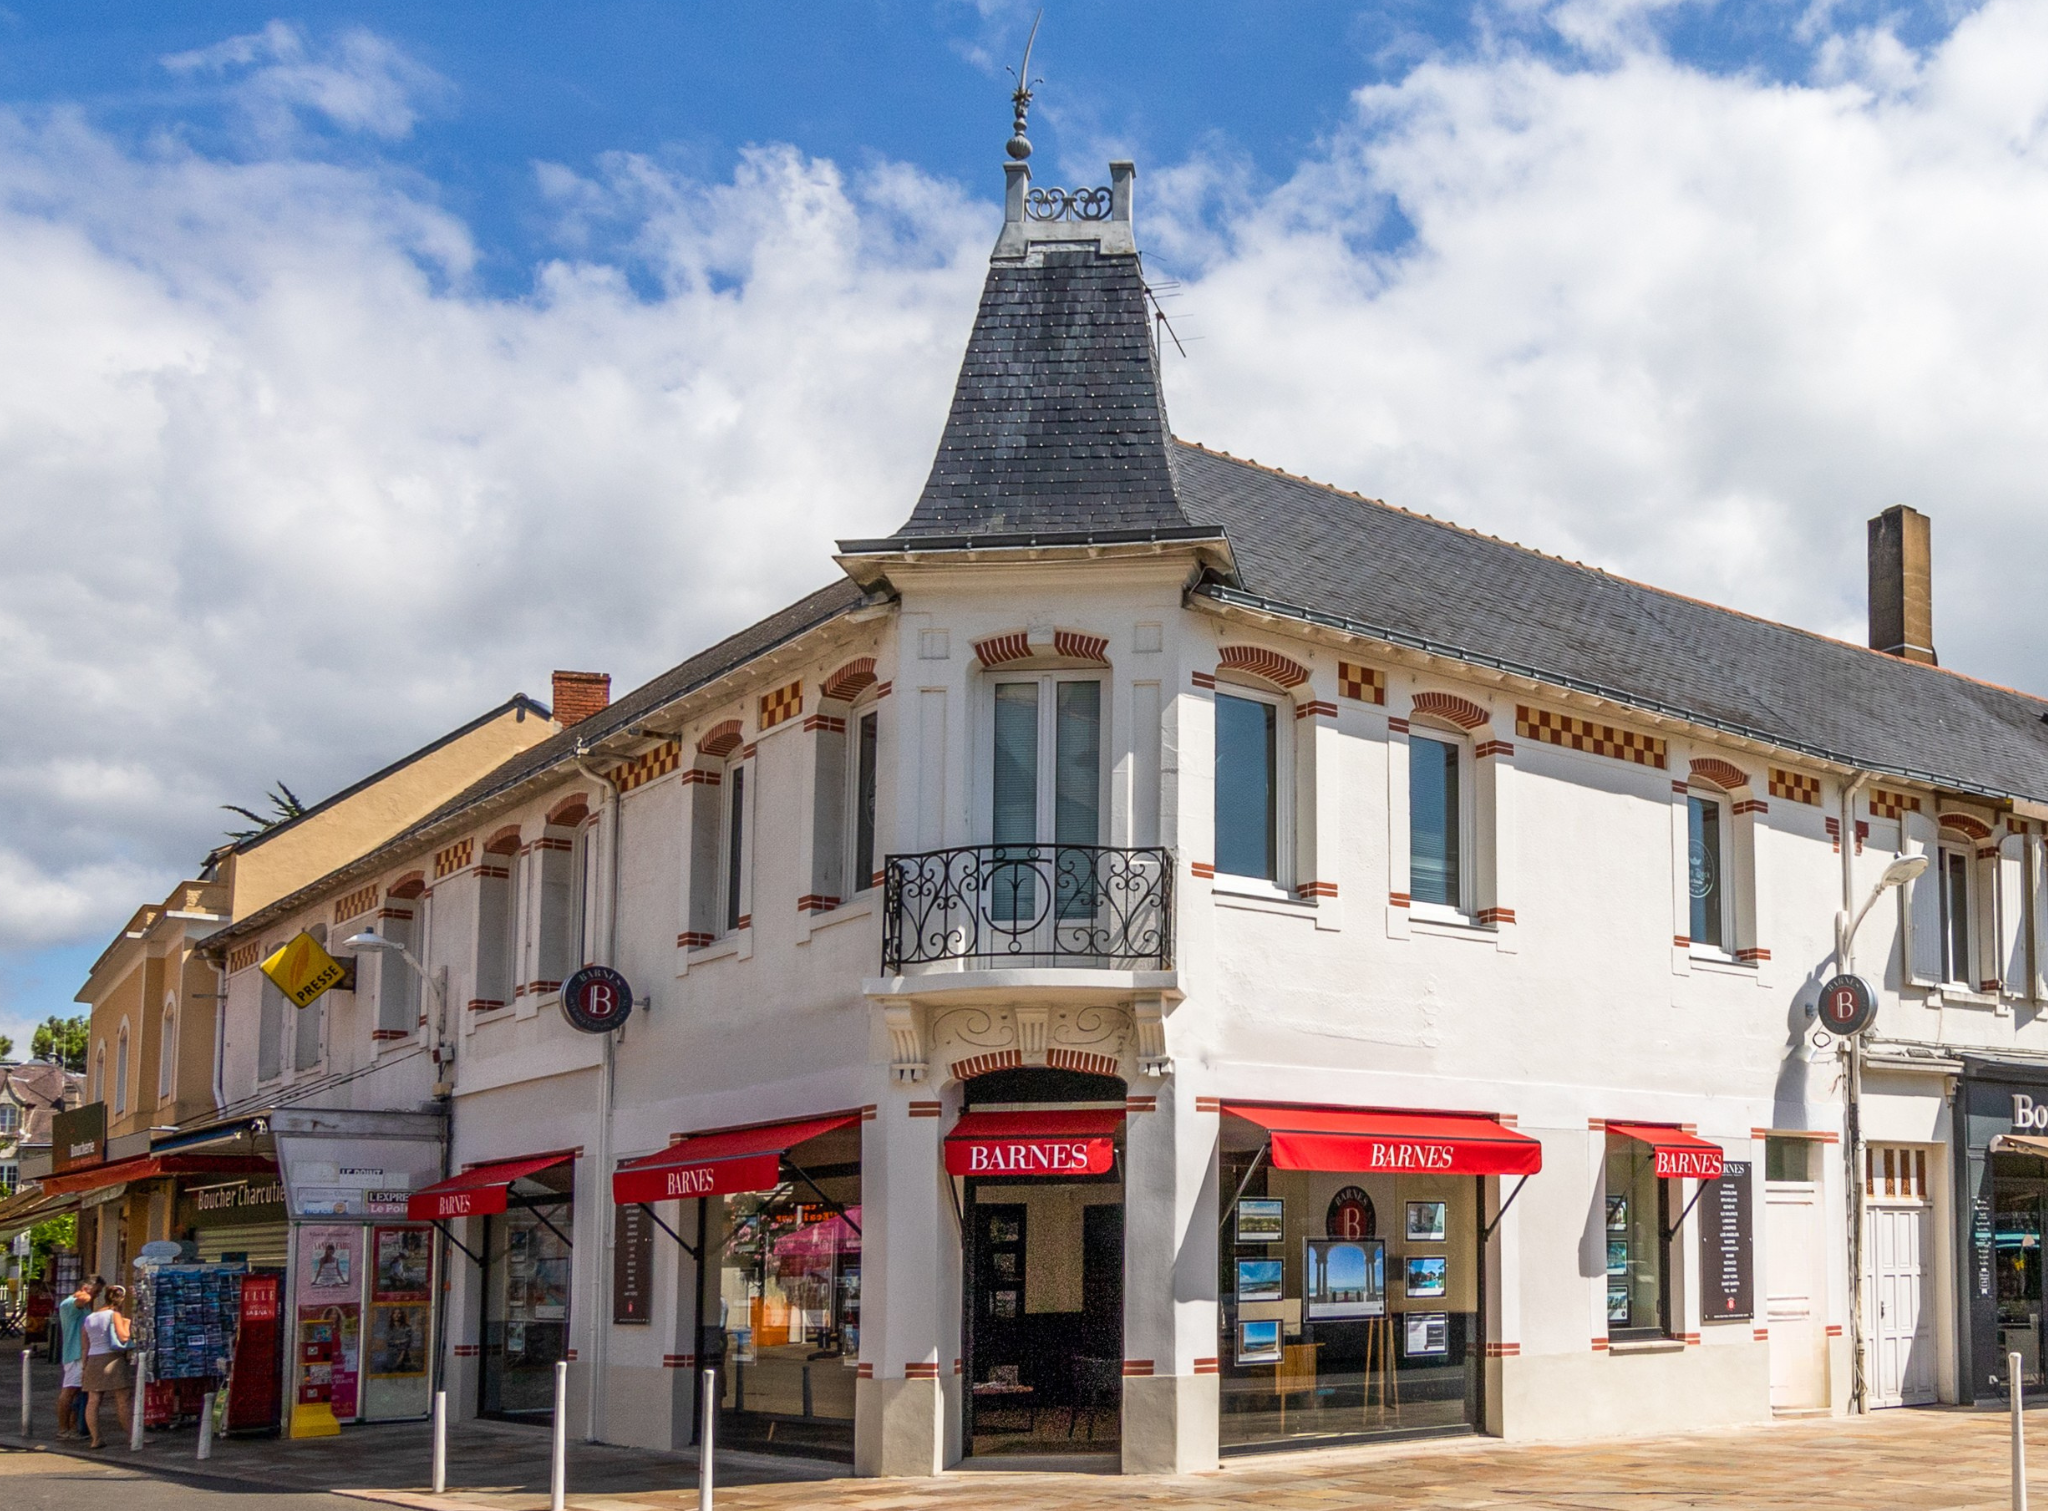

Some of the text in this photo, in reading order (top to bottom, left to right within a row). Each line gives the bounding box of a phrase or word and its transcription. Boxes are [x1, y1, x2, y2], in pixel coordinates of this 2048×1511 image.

[296, 965, 339, 1001] PRESSE
[578, 969, 621, 986] BARNES
[589, 985, 612, 1014] B
[1836, 991, 1854, 1019] B
[969, 1143, 1088, 1171] BARNES
[1370, 1143, 1454, 1169] BARNES
[1657, 1152, 1722, 1175] BARNES
[1722, 1163, 1745, 1174] RNES
[667, 1167, 715, 1196] BARNES
[198, 1187, 237, 1211] Boucher
[371, 1204, 384, 1213] Le
[438, 1194, 471, 1215] BARNES
[1335, 1189, 1369, 1206] BARNES
[1344, 1207, 1360, 1240] B
[244, 1290, 276, 1302] ELLE
